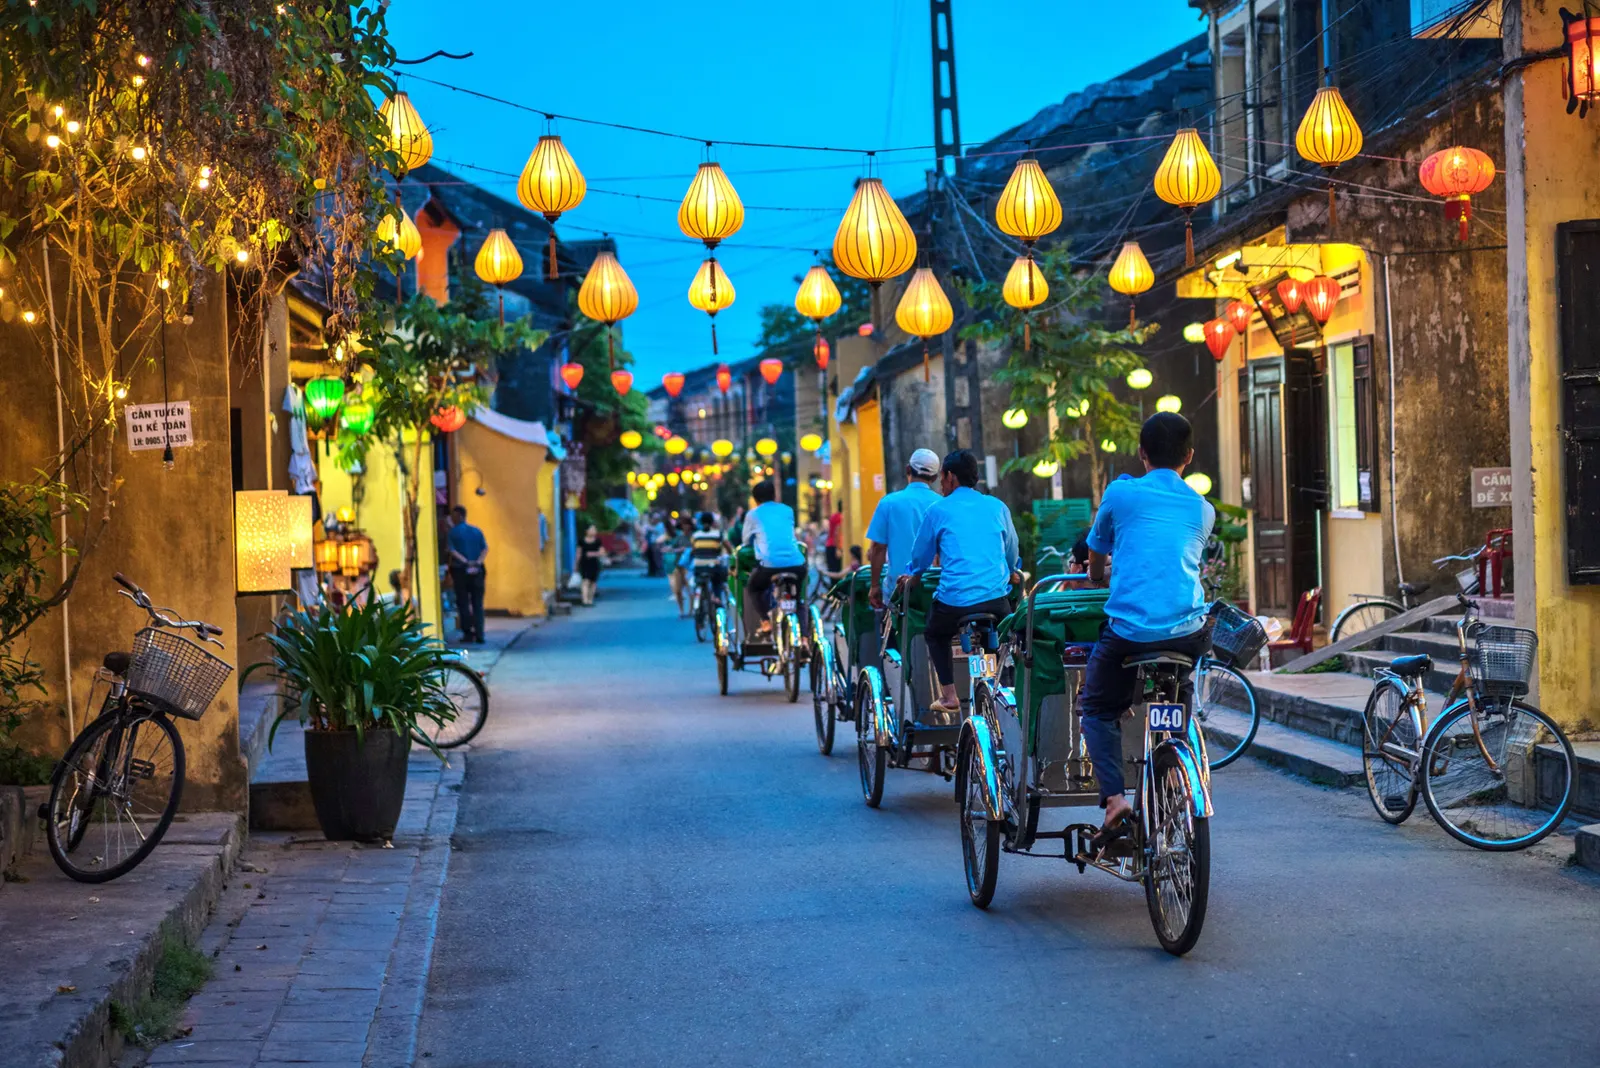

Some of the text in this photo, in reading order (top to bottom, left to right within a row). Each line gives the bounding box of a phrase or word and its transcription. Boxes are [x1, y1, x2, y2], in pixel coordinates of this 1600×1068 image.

[132, 425, 143, 433] 01
[146, 420, 158, 432] KẾ
[145, 434, 187, 445] 0905.10.539
[1481, 472, 1511, 486] CẤM
[971, 658, 995, 673] 101
[1150, 708, 1182, 728] 040
